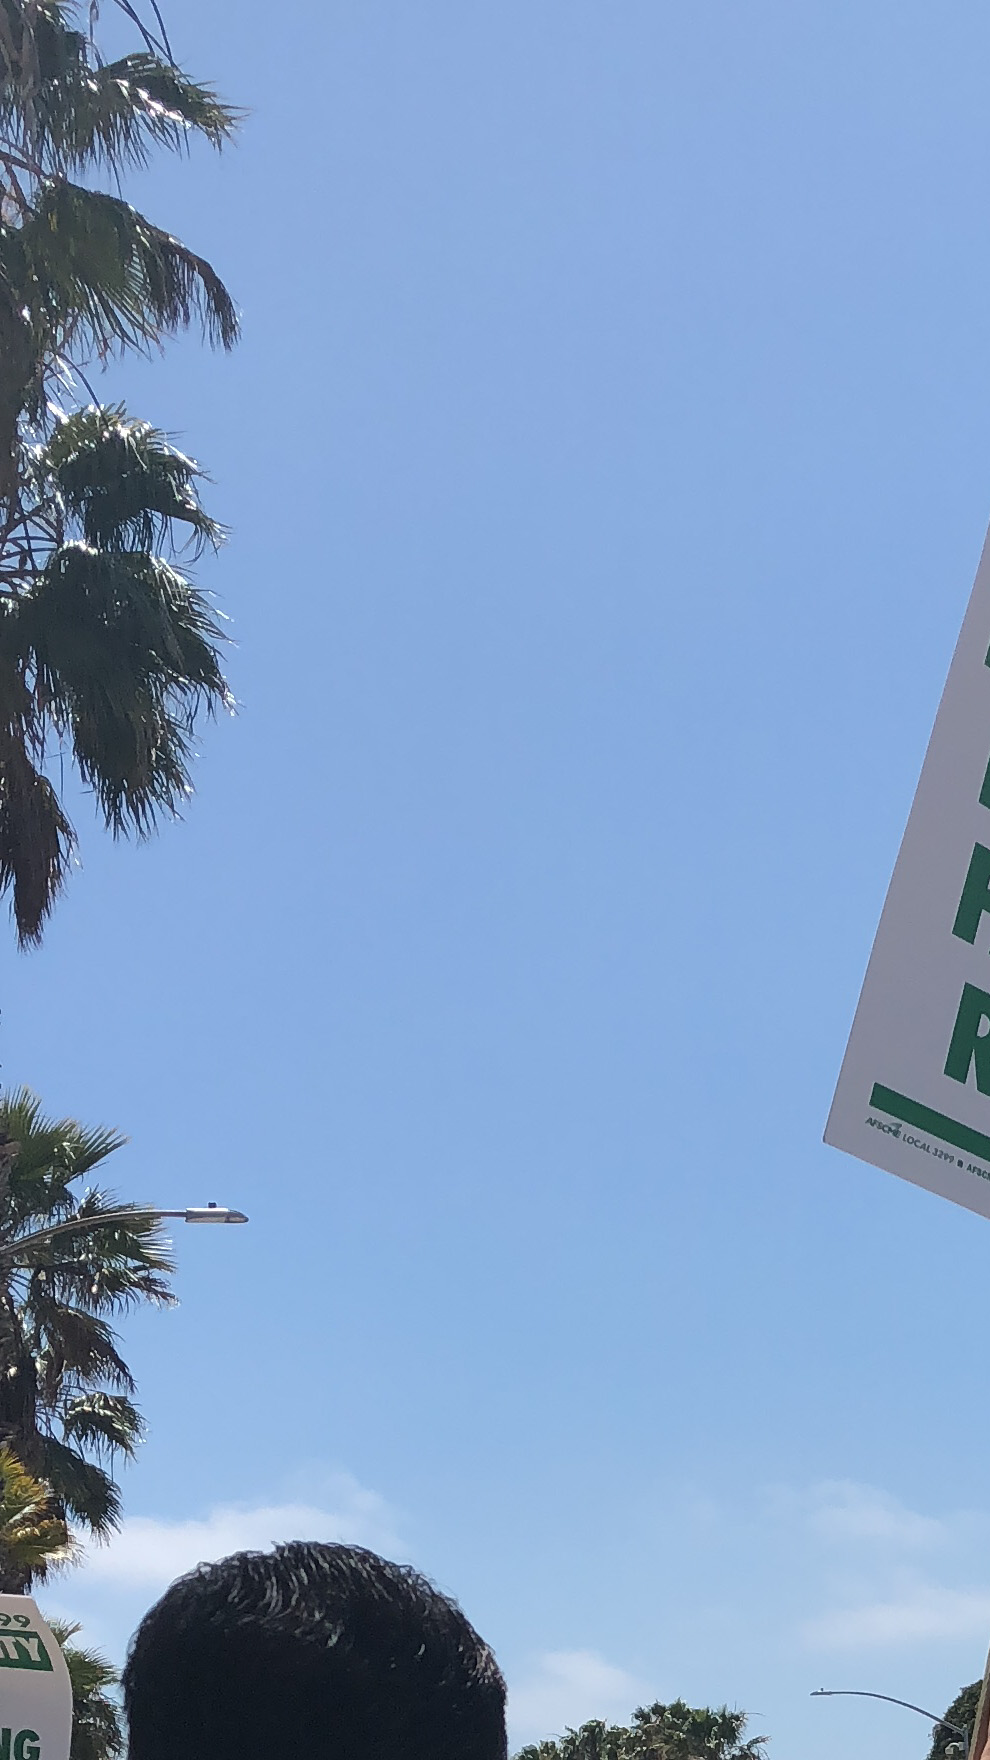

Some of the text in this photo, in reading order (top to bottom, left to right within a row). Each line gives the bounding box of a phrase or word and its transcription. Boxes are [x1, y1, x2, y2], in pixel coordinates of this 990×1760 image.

[865, 1117, 902, 1138] AFSCME
[902, 1134, 931, 1153] LOCAL
[932, 1147, 955, 1163] 3299
